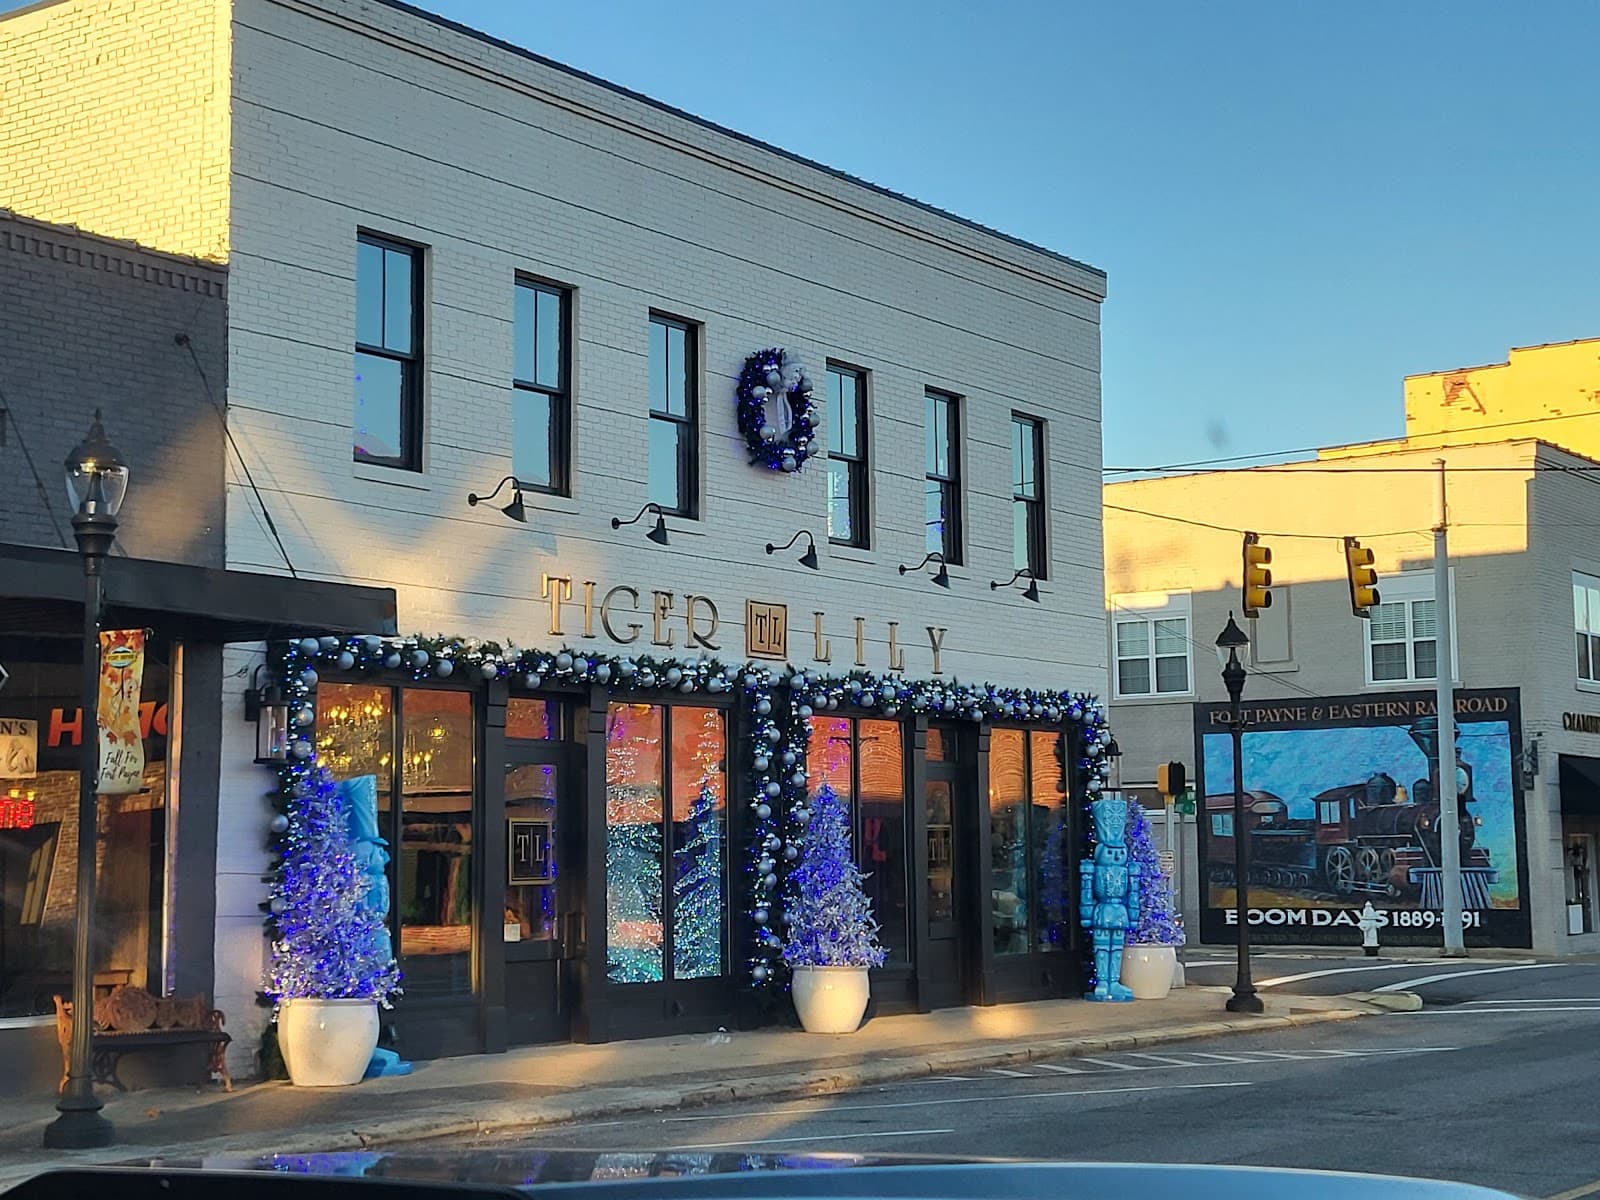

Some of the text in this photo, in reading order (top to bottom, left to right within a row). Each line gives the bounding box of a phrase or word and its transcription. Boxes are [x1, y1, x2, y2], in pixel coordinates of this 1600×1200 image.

[541, 572, 949, 675] TIGER TL LILY
[1210, 697, 1508, 725] FOT PAYNE & EASTERN RAROAD
[105, 748, 124, 767] Fall
